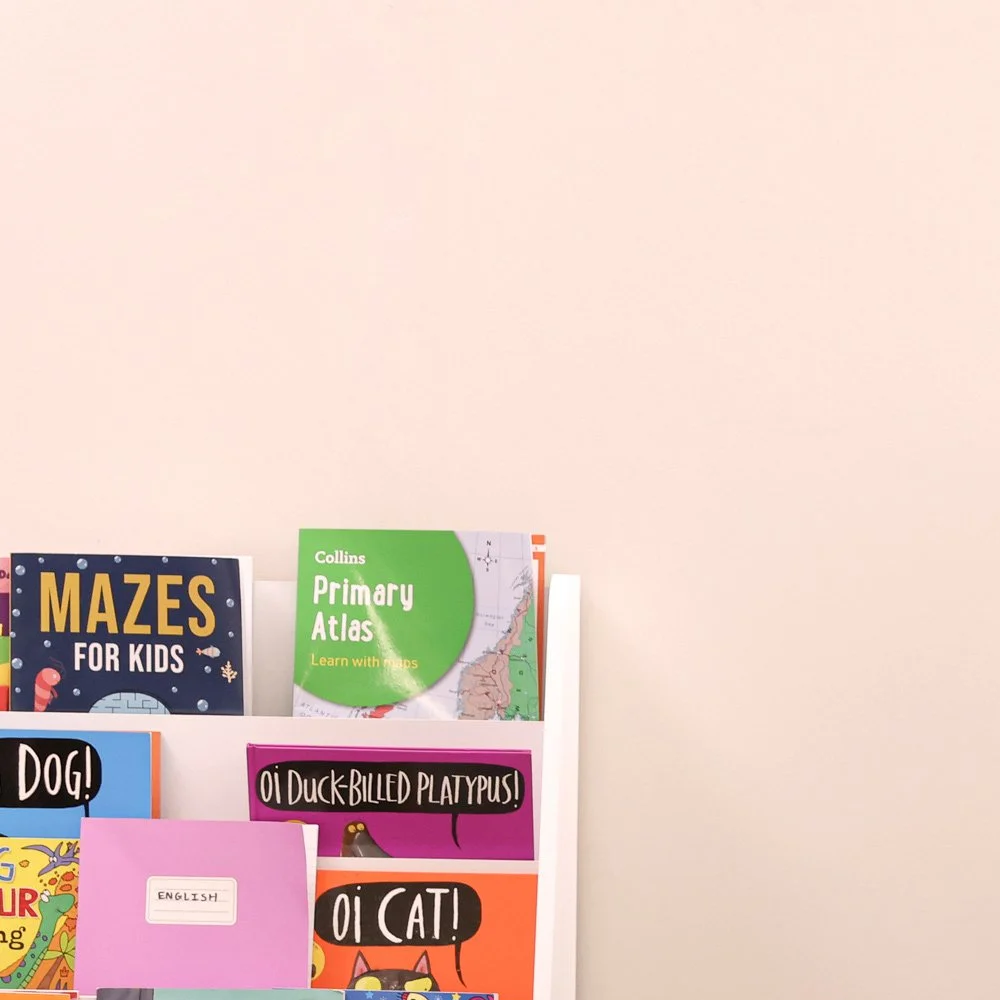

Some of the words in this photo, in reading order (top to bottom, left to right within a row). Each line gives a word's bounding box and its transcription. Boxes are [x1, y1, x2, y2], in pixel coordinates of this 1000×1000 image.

[314, 550, 366, 565] Collins
[40, 571, 216, 637] MAZES
[313, 575, 414, 611] Primary
[311, 611, 374, 642] Atlas
[74, 642, 120, 672] FOR
[129, 643, 184, 674] KIDS
[311, 654, 349, 667] Learn
[352, 656, 380, 668] with
[384, 658, 418, 669] maps
[18, 743, 92, 801] DOG!
[417, 770, 520, 808] PLATYPUS!
[158, 891, 218, 902] ENGLISH
[378, 887, 459, 943] CAT!
